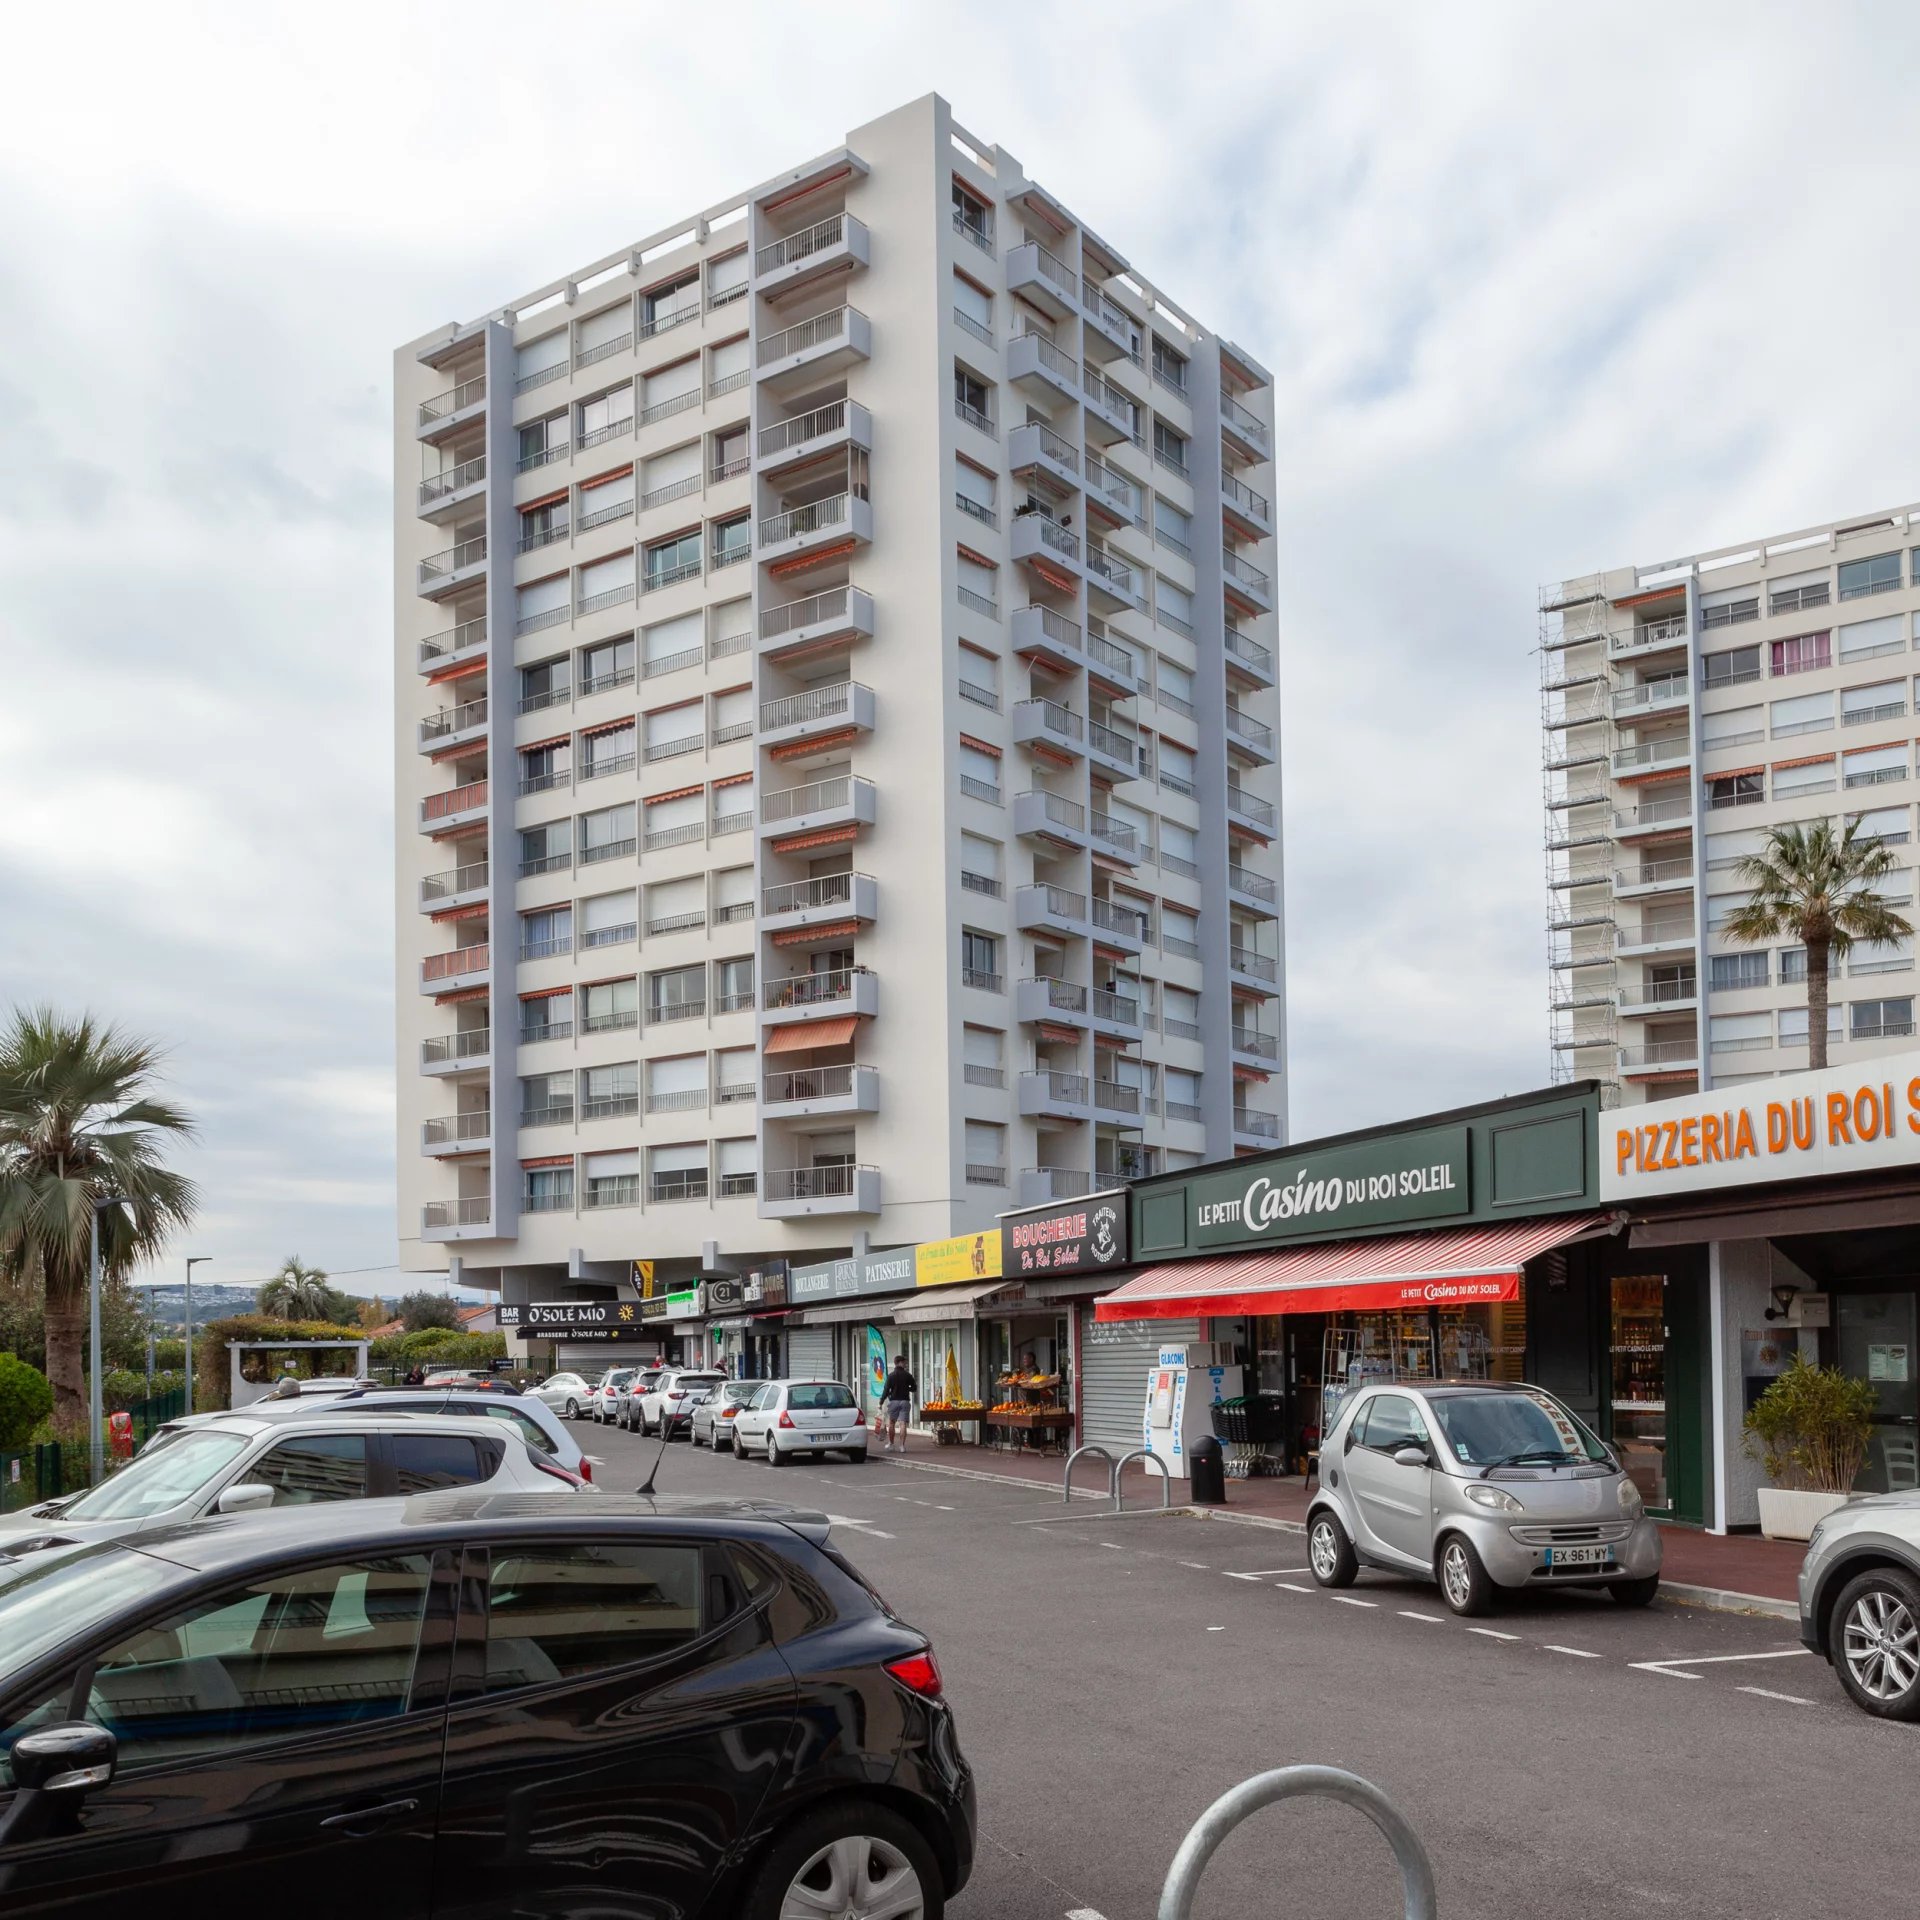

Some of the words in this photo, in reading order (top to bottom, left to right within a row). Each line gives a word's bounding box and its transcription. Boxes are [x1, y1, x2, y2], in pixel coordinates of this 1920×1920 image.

[1616, 1107, 1757, 1176] PIZZERIA
[1767, 1095, 1813, 1154] DU
[1826, 1082, 1892, 1146] ROI
[1198, 1205, 1211, 1227] LE
[1212, 1199, 1242, 1225] PETIT
[1243, 1168, 1343, 1232] Casino
[1346, 1178, 1366, 1205] DU
[1368, 1173, 1397, 1201] ROI
[1399, 1163, 1456, 1196] SOLEIL
[1092, 1206, 1117, 1227] TRAITEUR
[1012, 1212, 1087, 1249] BOUCHERIE
[865, 1258, 911, 1284] PATISSERIE
[719, 1287, 730, 1298] 21
[795, 1273, 830, 1294] BOULANGERIE
[1401, 1288, 1408, 1298] LE
[1408, 1288, 1422, 1298] PETIT
[1423, 1282, 1458, 1301] Casino
[1459, 1285, 1467, 1295] DU
[1467, 1284, 1479, 1295] ROI
[1480, 1283, 1501, 1294] SOLEIL
[501, 1307, 519, 1318] BAR
[578, 1307, 606, 1321] MIO
[1160, 1353, 1185, 1365] GLACONS
